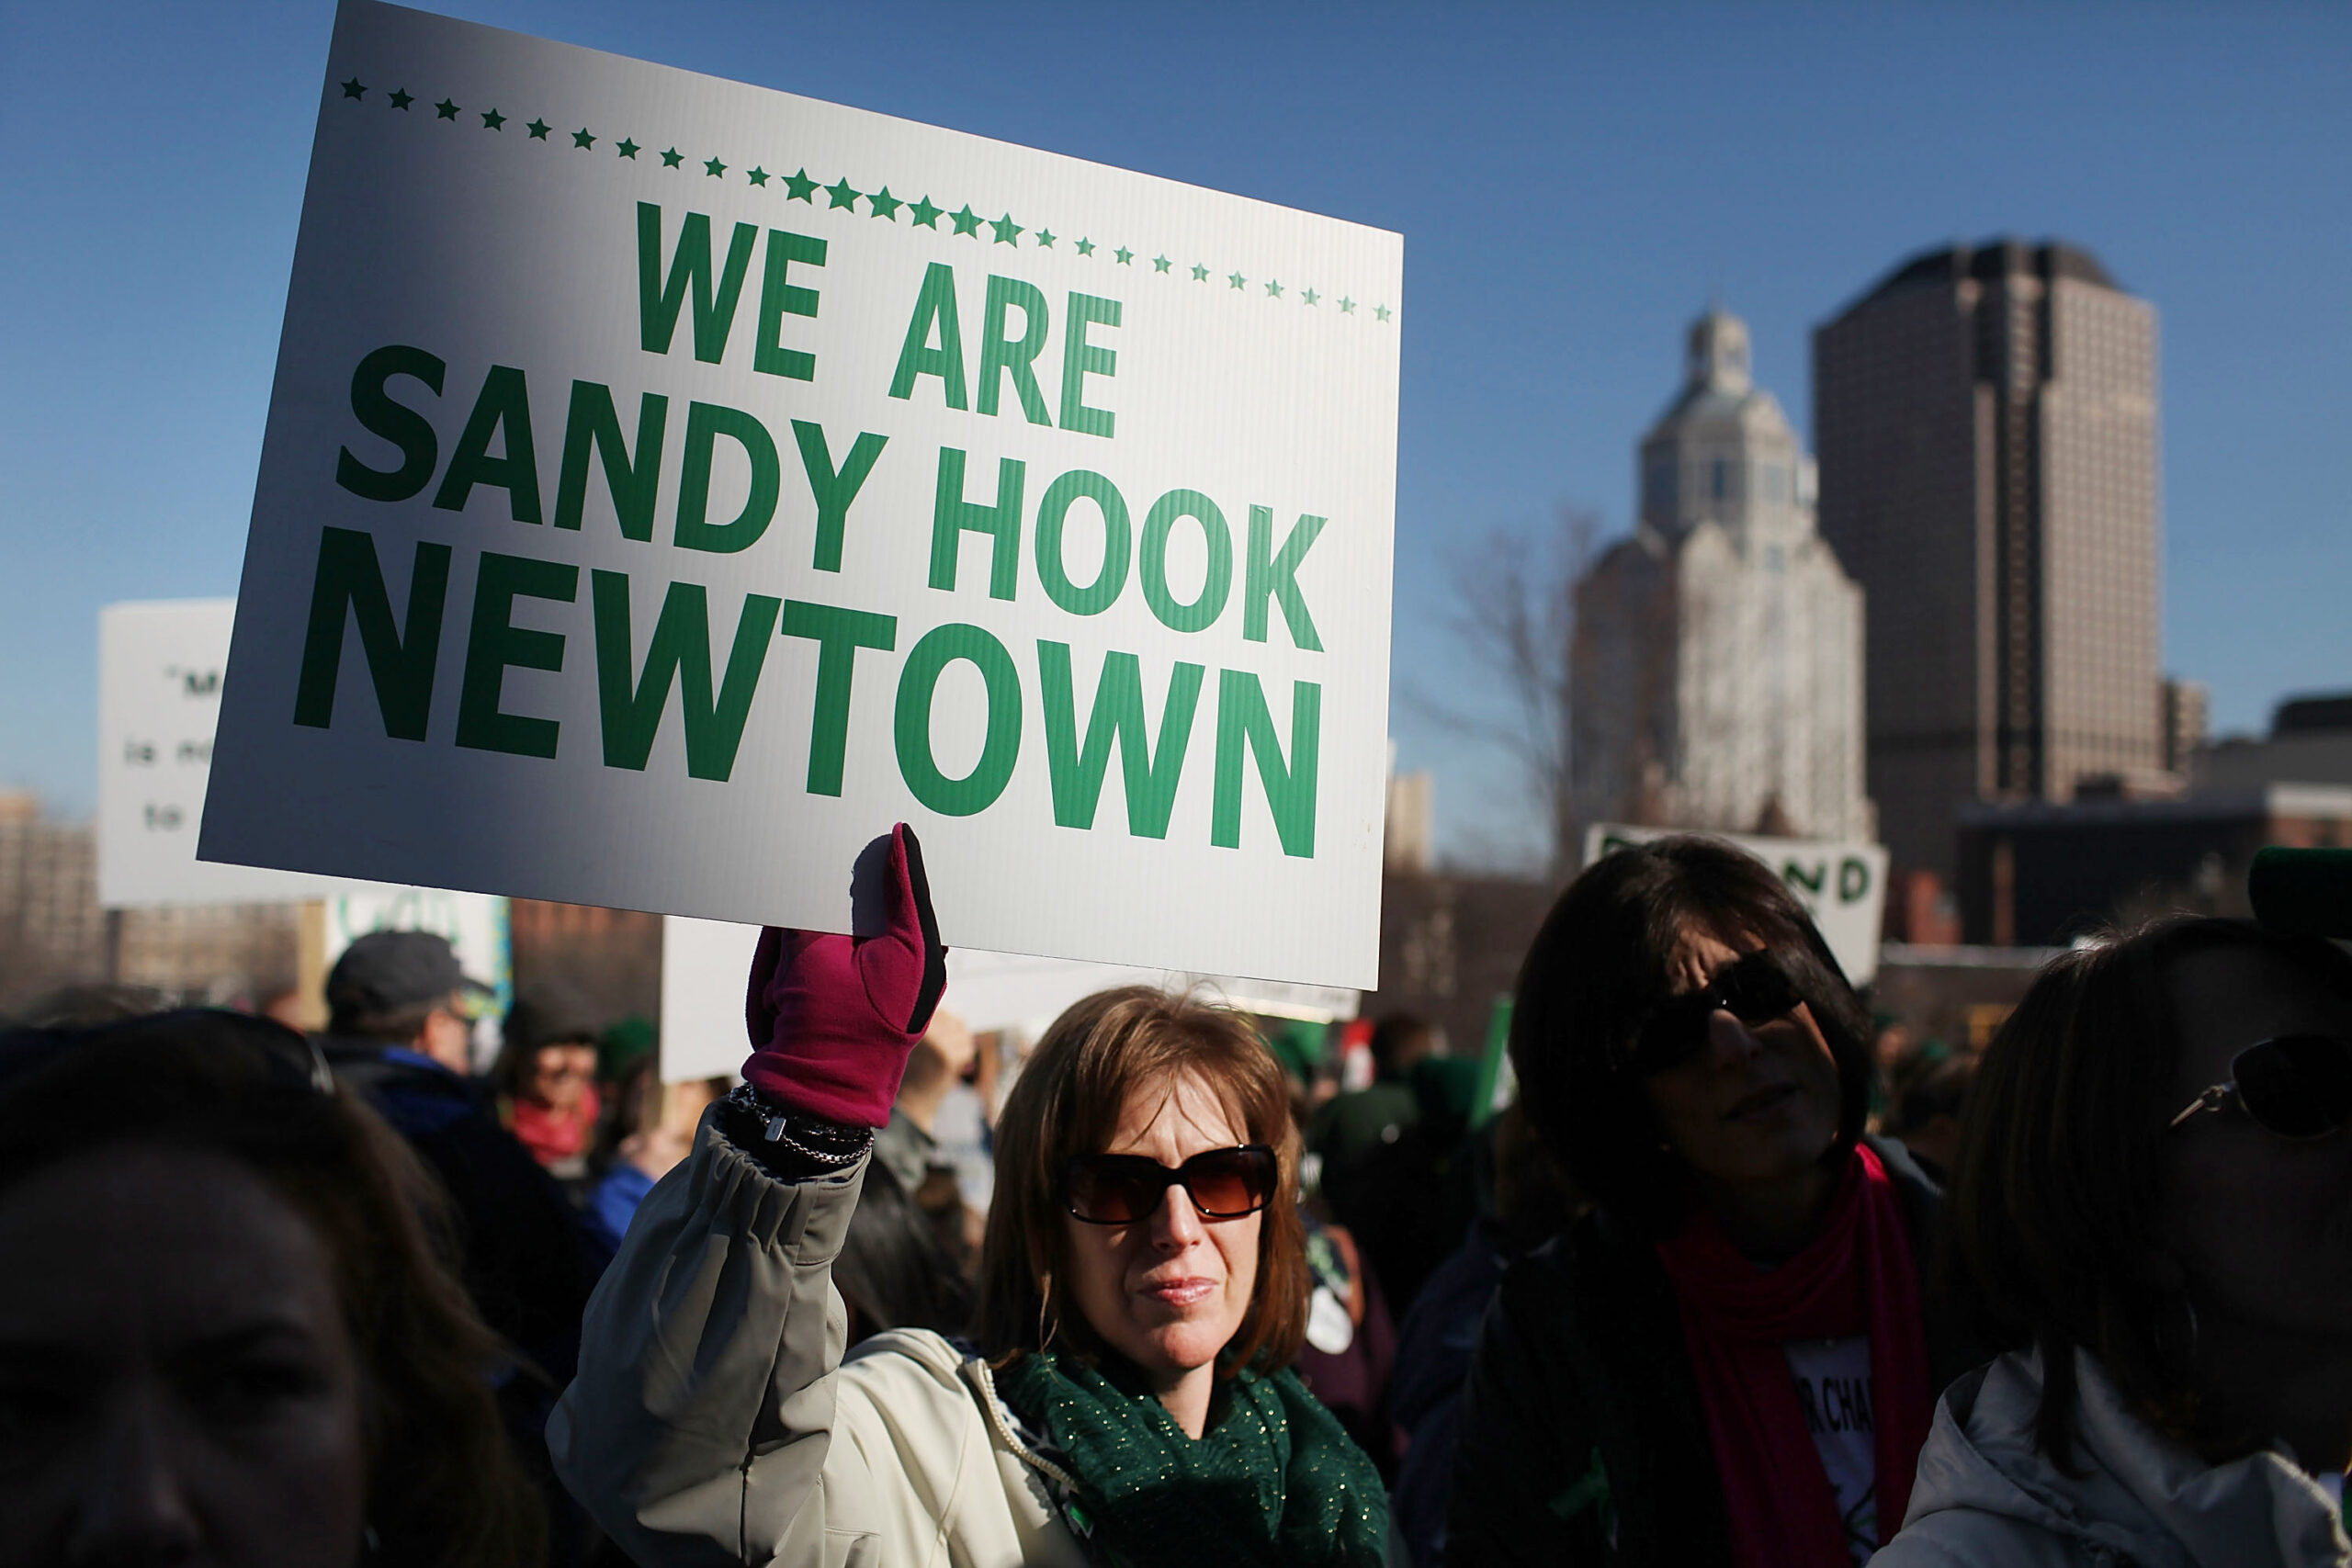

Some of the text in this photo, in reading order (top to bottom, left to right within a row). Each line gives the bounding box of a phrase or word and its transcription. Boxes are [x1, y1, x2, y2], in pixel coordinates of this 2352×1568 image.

[638, 201, 1122, 438] WE ARE
[336, 345, 1327, 653] SANDY HOOK
[294, 524, 1323, 860] NEWTOWN
